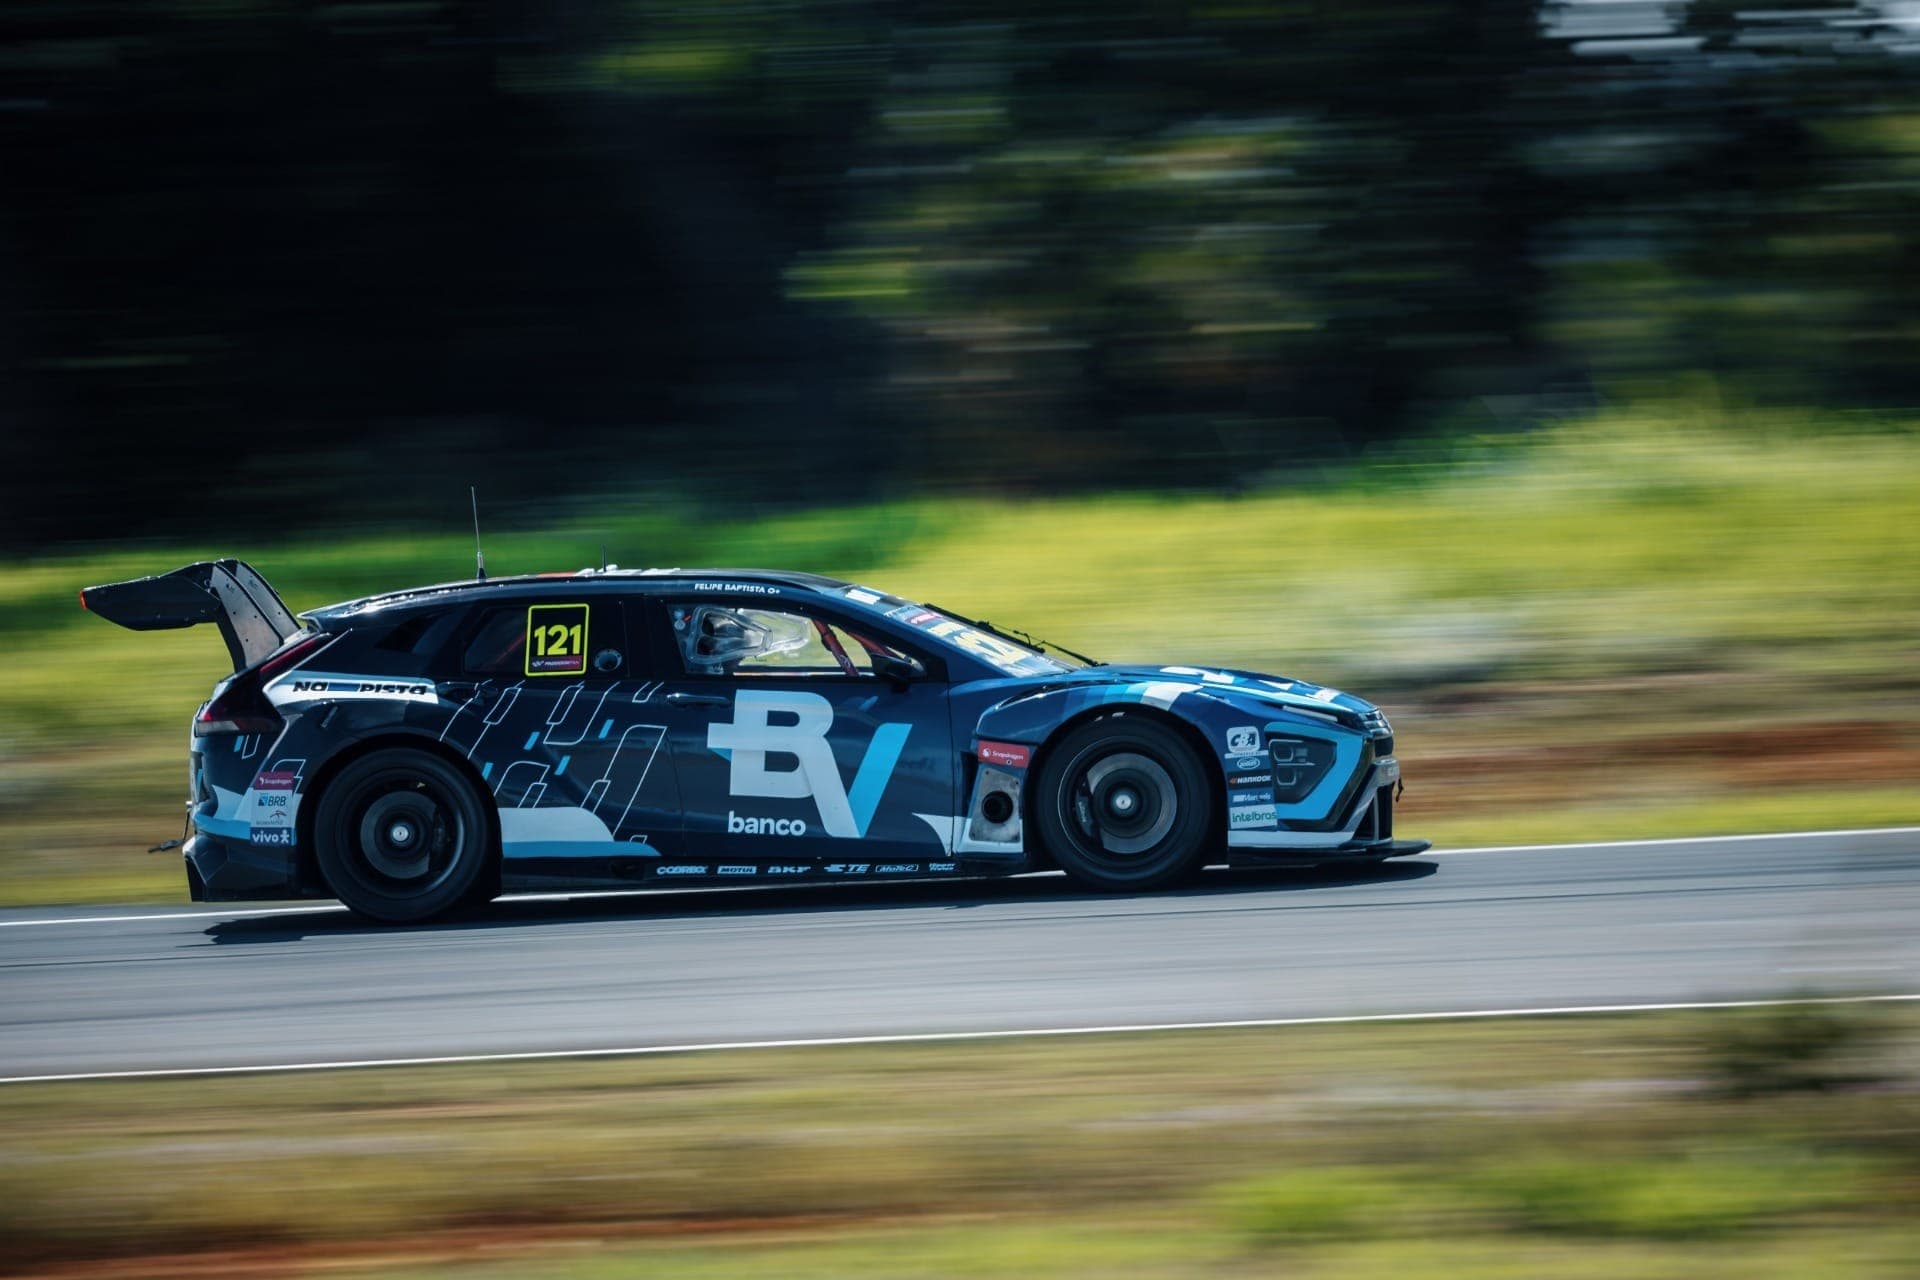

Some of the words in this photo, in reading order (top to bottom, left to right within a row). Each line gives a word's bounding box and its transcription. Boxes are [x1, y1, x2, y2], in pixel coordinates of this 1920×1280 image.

[694, 583, 723, 591] FELIPE
[724, 583, 766, 594] BAPTISTA
[534, 623, 582, 656] 121
[268, 795, 287, 807] BRB
[727, 810, 807, 837] banco
[1232, 811, 1277, 824] intelbras
[252, 829, 279, 844] vivo
